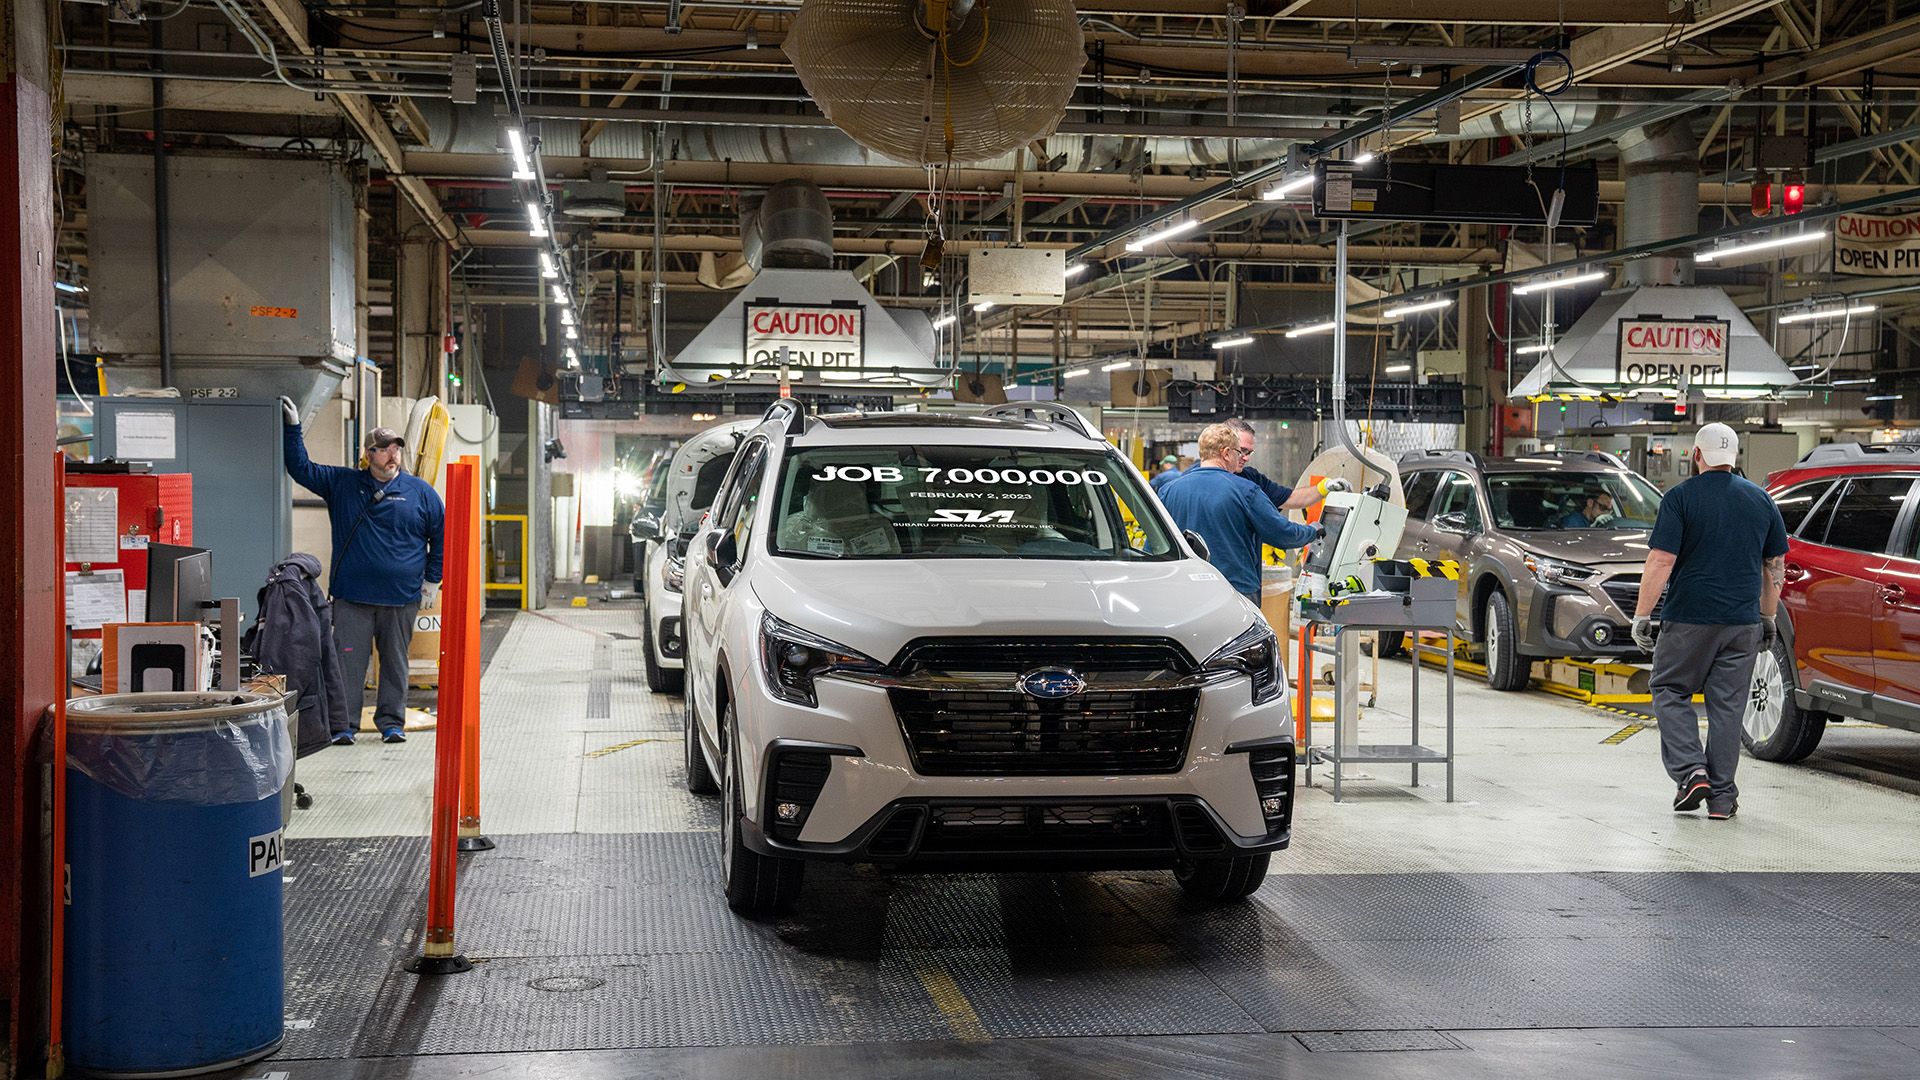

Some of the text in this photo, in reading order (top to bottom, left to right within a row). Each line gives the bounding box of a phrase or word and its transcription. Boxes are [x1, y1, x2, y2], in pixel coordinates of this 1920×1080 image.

[1838, 215, 1920, 238] CAUTION
[1840, 248, 1920, 269] OPEN PIT
[753, 311, 855, 336] CAUTION
[1626, 326, 1721, 349] CAUTION
[822, 352, 855, 367] PIT
[1626, 363, 1722, 385] OPEN PIT
[190, 388, 237, 398] PSF 2-2
[1719, 436, 1729, 449] B
[811, 465, 1109, 487] JOB 7,000,000
[909, 491, 1033, 501] FEBRUARY 2, 2023
